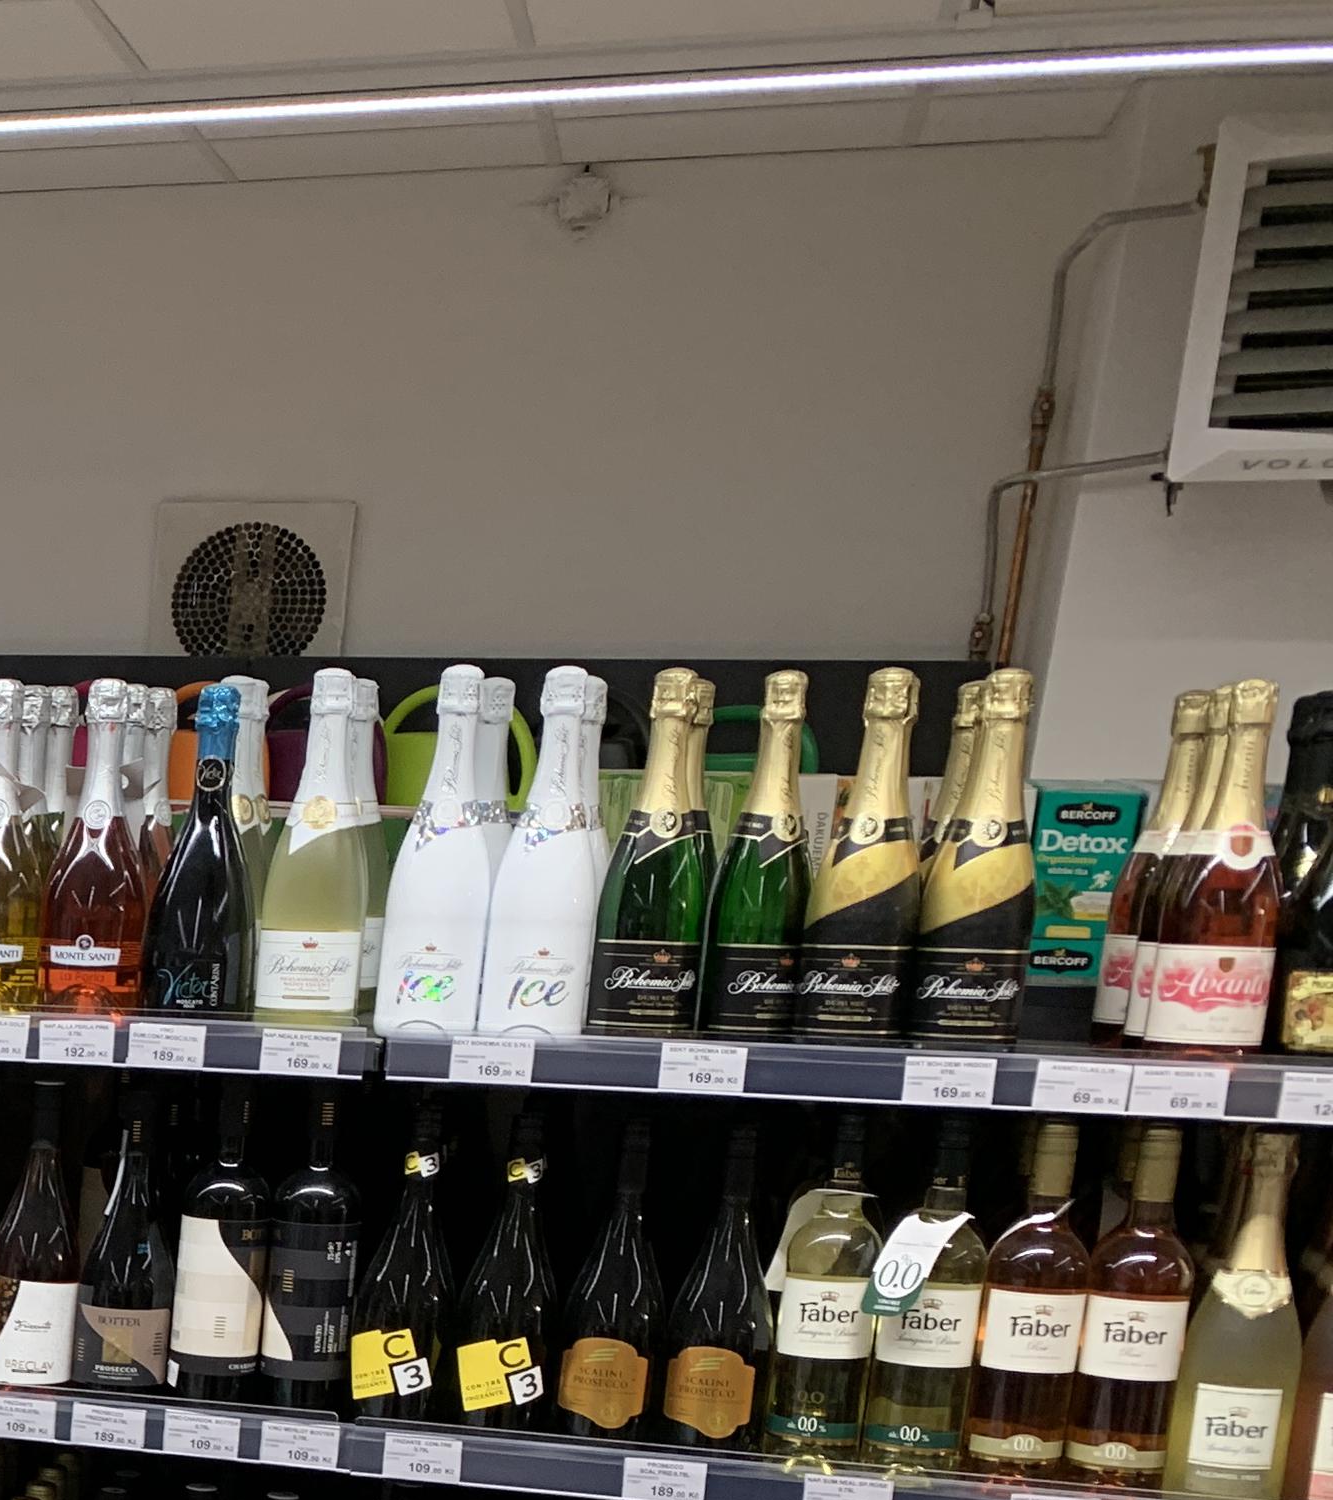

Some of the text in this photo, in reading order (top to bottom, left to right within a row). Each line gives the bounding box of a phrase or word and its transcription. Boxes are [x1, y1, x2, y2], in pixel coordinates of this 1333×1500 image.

[1061, 808, 1116, 821] BERCOFF
[1039, 829, 1128, 854] Detox
[54, 950, 116, 961] MONTE SANTI
[878, 1259, 921, 1291] 0.0
[800, 1302, 858, 1325] Faber
[900, 1309, 961, 1332] Faber
[1010, 1315, 1071, 1338] Faber
[1104, 1321, 1168, 1345] Faber
[383, 1334, 409, 1358] C
[499, 1342, 526, 1367] C
[403, 1364, 424, 1390] 3
[518, 1372, 538, 1397] 3
[573, 1374, 629, 1390] PROSECCO
[1205, 1416, 1268, 1440] Faber
